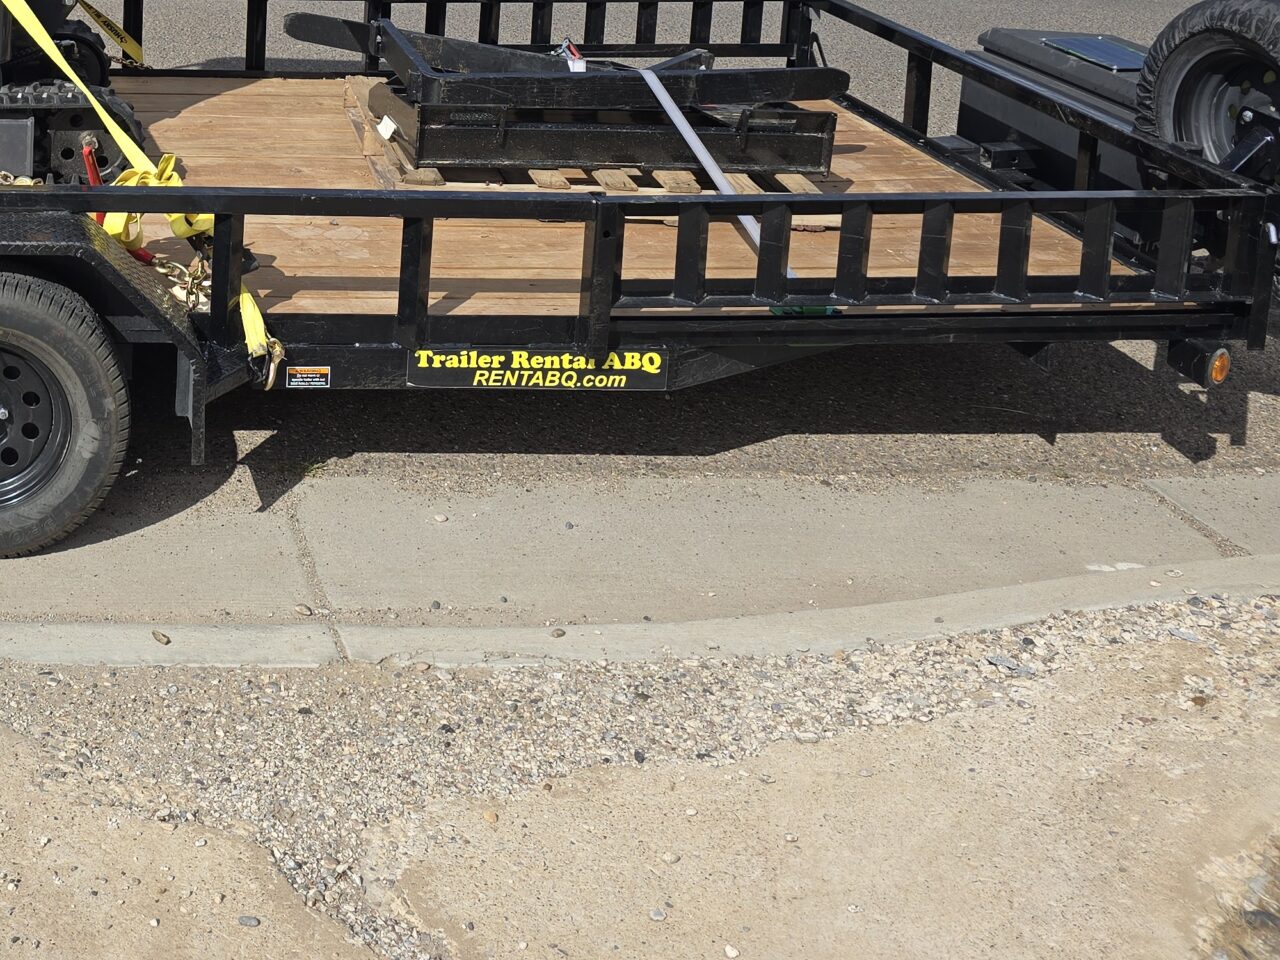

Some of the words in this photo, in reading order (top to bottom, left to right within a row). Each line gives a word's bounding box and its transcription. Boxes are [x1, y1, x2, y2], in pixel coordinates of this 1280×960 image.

[415, 350, 506, 369] Trailer
[602, 351, 662, 374] ABQ
[472, 370, 627, 388] RENTABQ.com
